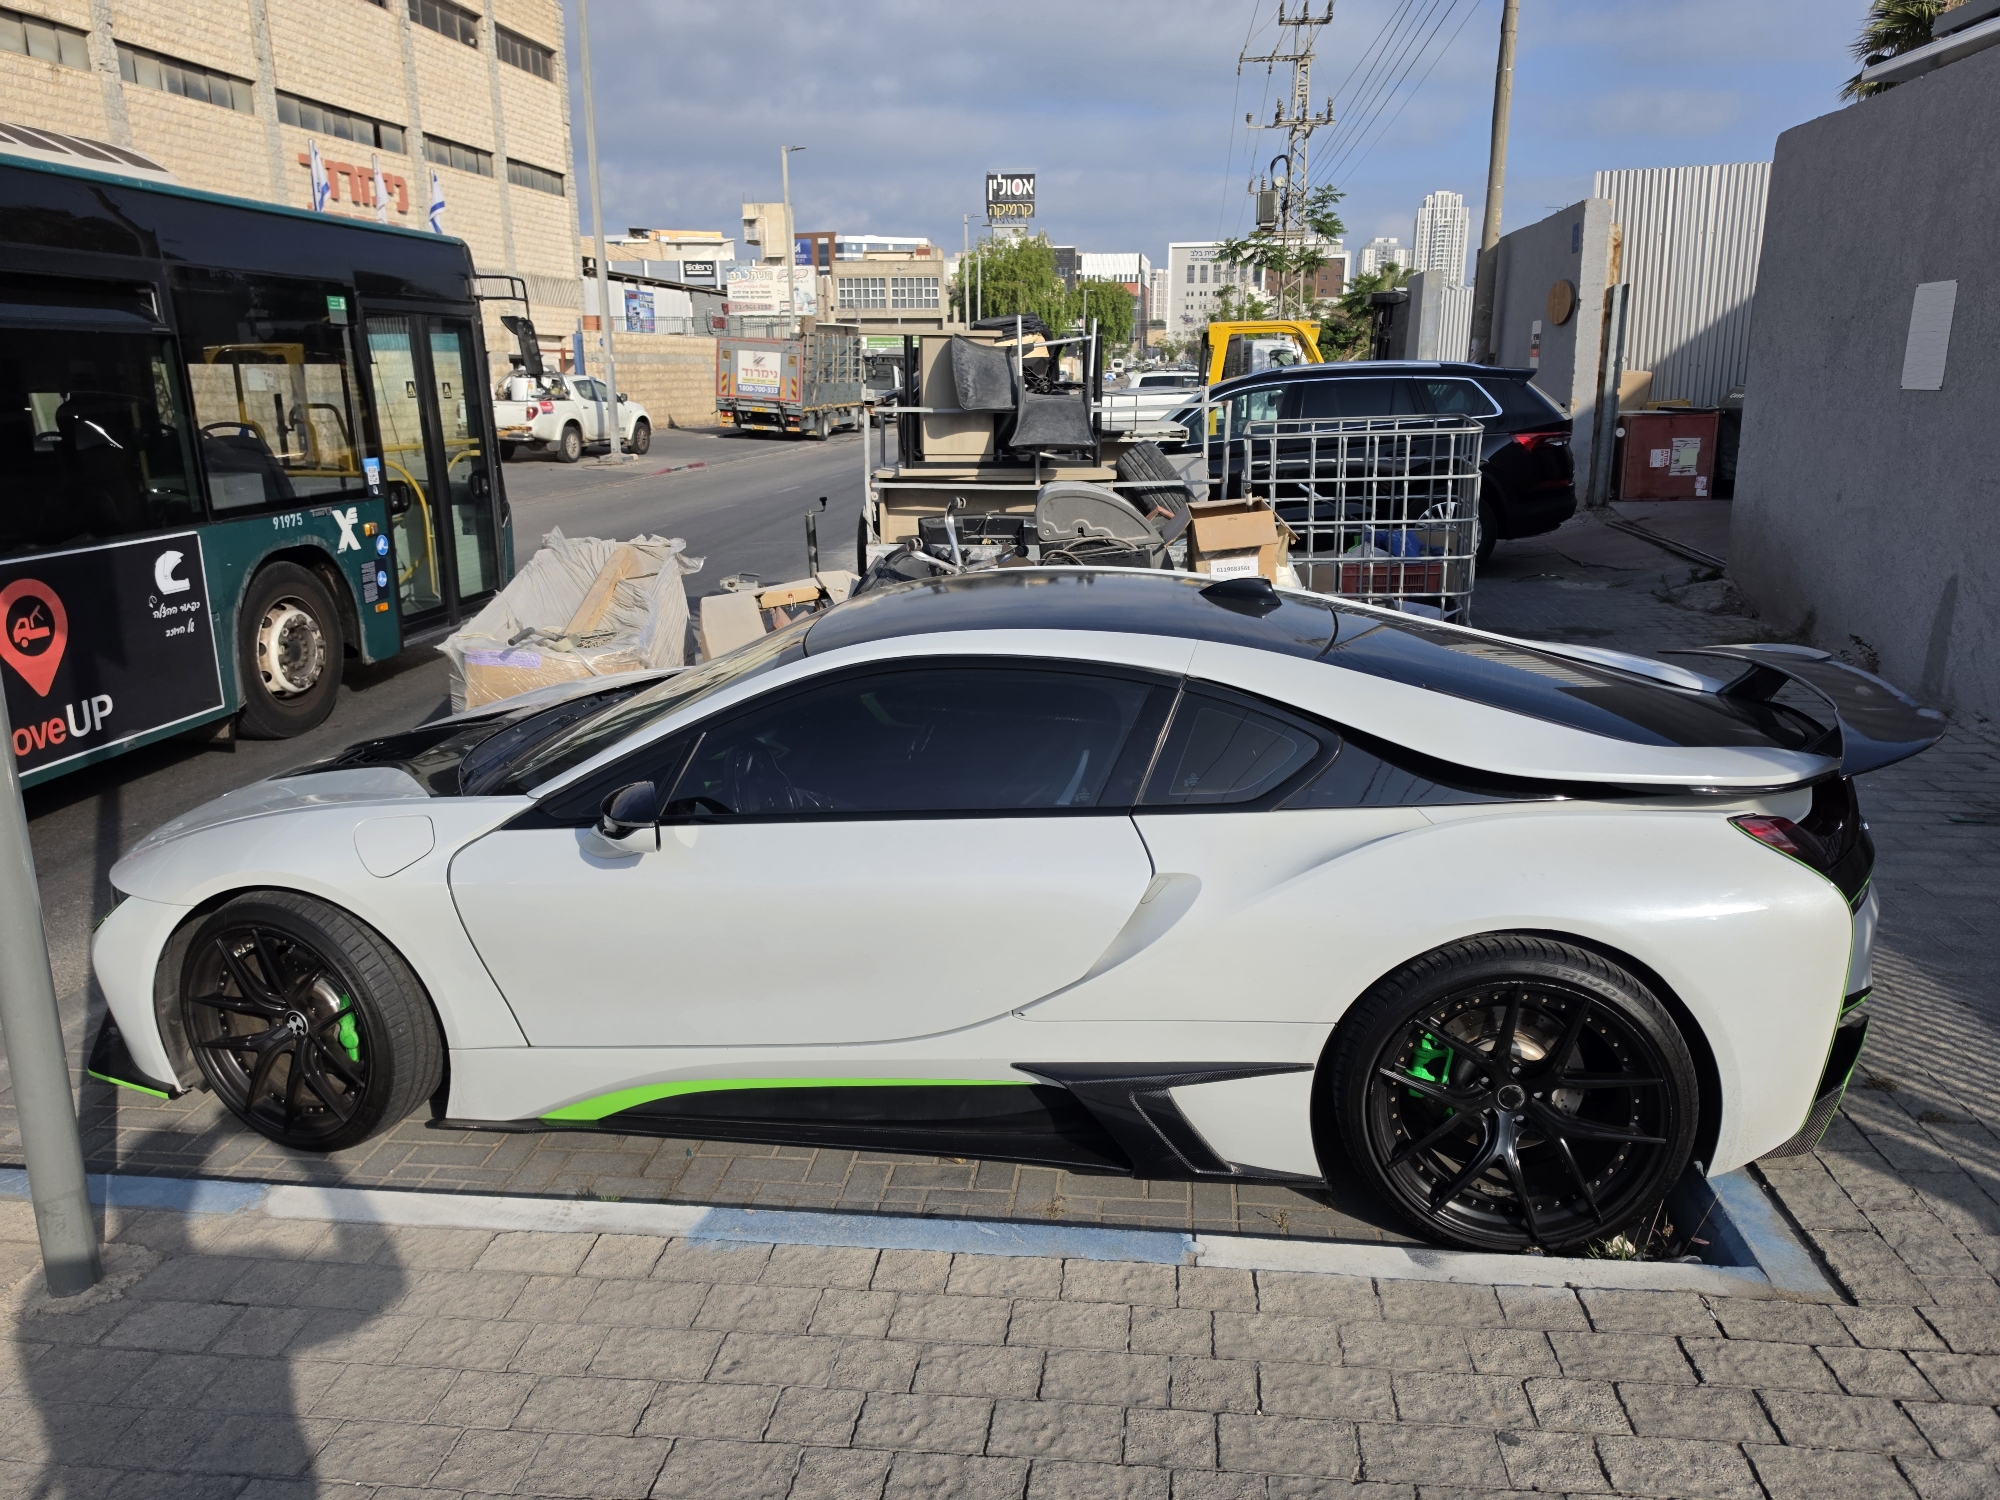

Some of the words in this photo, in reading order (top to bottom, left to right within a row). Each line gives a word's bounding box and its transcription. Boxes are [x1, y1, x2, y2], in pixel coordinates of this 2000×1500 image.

[988, 173, 1034, 201] אסולין
[988, 203, 1034, 219] קרמיקה
[1190, 249, 1203, 257] בלב
[685, 263, 713, 271] Solero
[745, 270, 773, 281] חשמל
[741, 367, 778, 379] נימרוד
[738, 384, 778, 394] 1800-700-333
[272, 512, 303, 530] 91975
[152, 602, 178, 619] ההצלה
[179, 601, 201, 612] כפתור
[187, 617, 195, 634] של
[12, 693, 114, 757] oveUP
